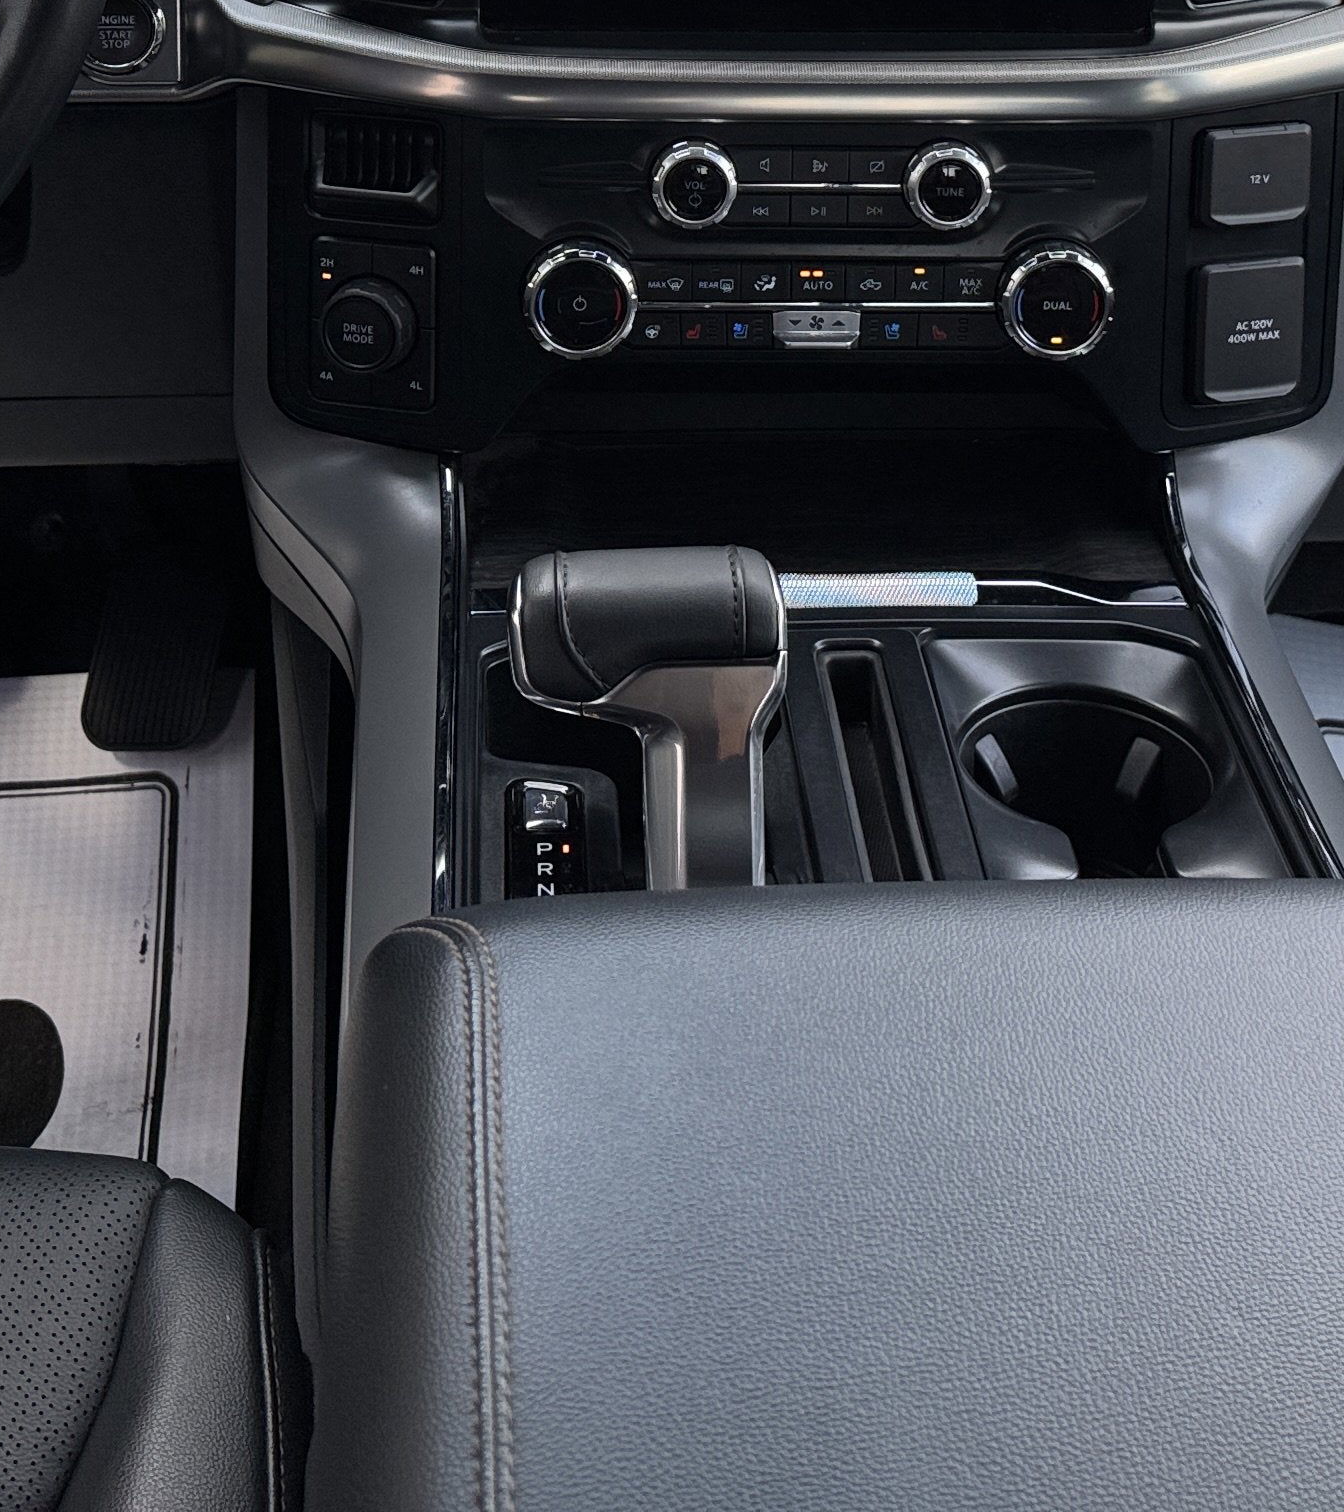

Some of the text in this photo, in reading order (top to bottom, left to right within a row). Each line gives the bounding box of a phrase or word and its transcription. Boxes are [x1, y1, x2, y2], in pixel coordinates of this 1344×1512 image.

[99, 15, 136, 25] NGINE
[99, 30, 133, 40] START
[102, 39, 131, 49] STOP
[1250, 174, 1270, 185] 12 V
[684, 180, 706, 190] VOL
[935, 187, 965, 197] TUNE
[320, 257, 335, 268] 2H
[409, 265, 424, 276] 4H
[648, 280, 667, 289] MAX
[698, 280, 719, 289] REAR
[803, 280, 834, 291] AUTO
[910, 281, 930, 291] A/C
[959, 278, 983, 288] MAX
[962, 287, 982, 296] A/C
[1043, 301, 1073, 311] DUAL
[343, 323, 374, 335] DRIVE
[1236, 319, 1274, 331] AC 120V
[343, 333, 374, 345] MODE
[1228, 330, 1281, 344] 400W MAX
[320, 371, 334, 382] 4A
[410, 381, 424, 391] 4L
[537, 842, 553, 856] P
[537, 862, 554, 876] R
[537, 883, 555, 897] N
